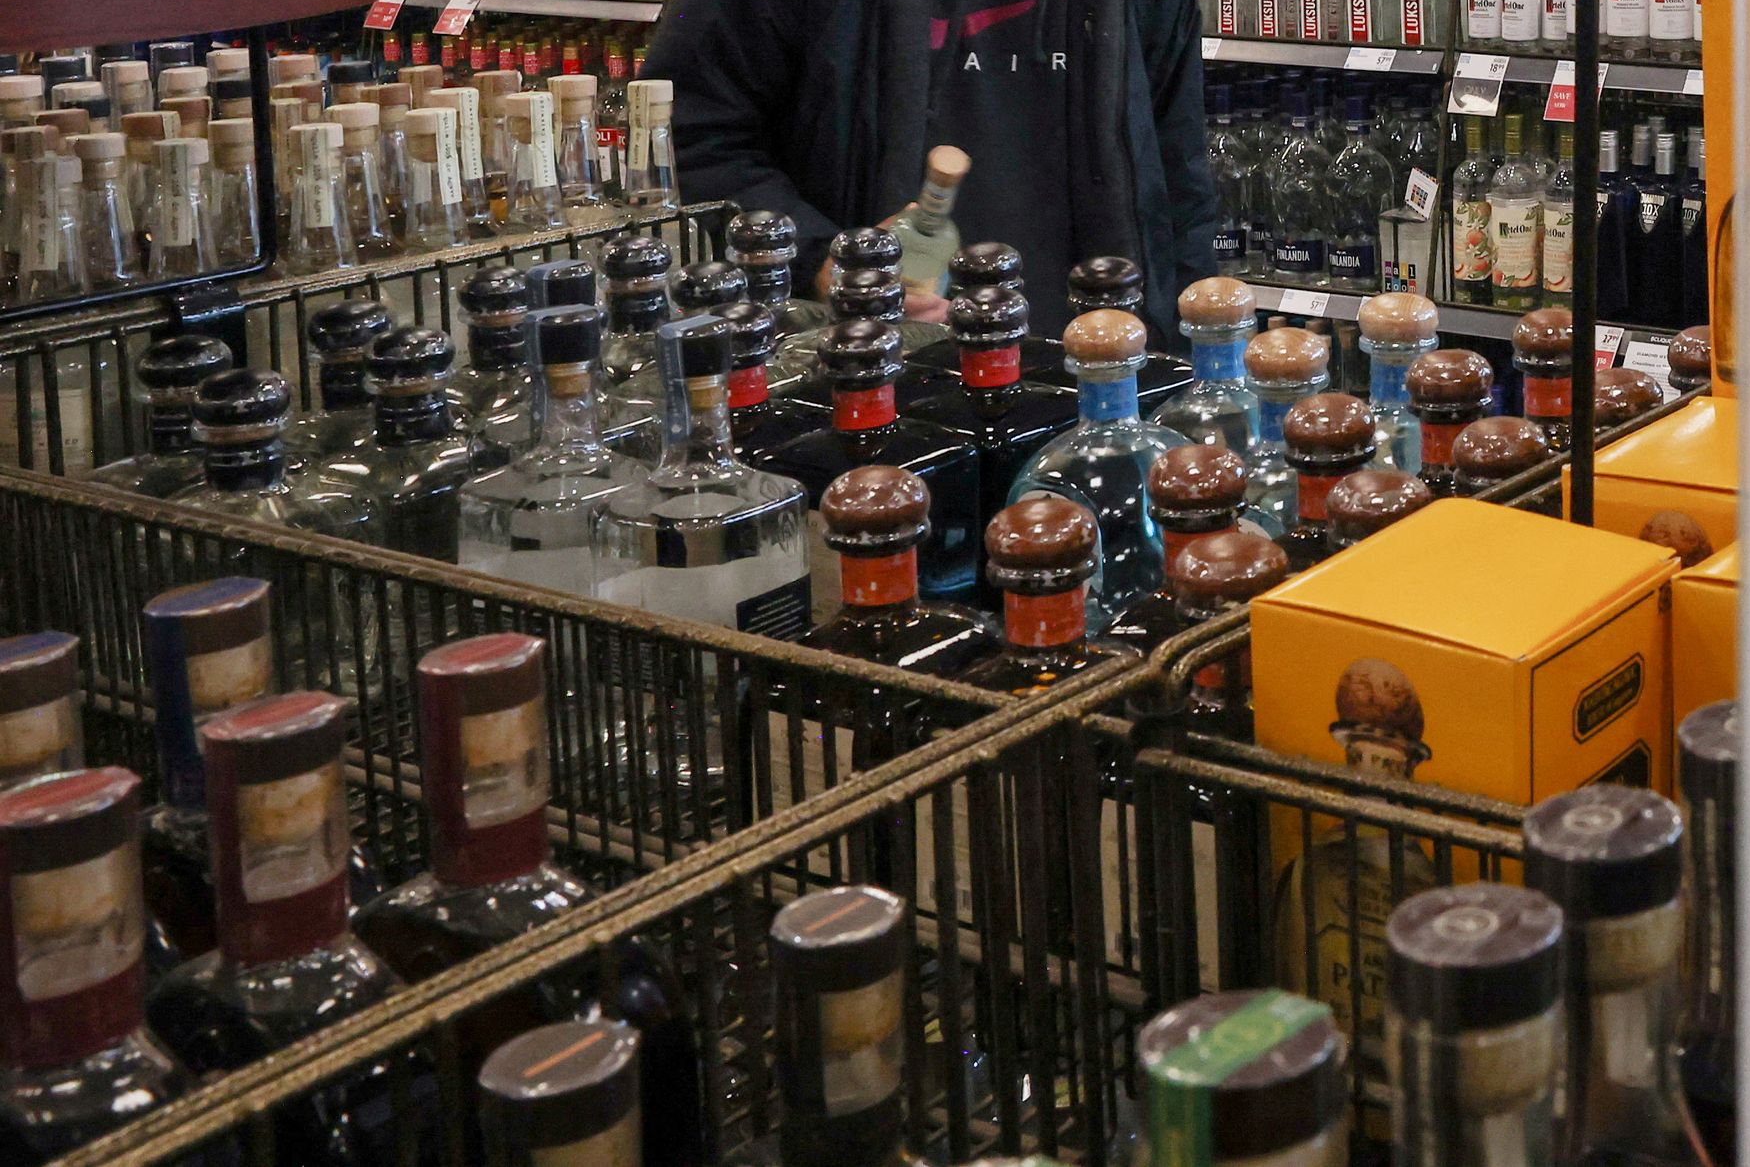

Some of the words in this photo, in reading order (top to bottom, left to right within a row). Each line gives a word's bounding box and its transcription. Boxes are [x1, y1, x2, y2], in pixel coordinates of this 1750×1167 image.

[963, 51, 1067, 72] AIR
[1553, 92, 1571, 100] SAVE
[1642, 203, 1660, 216] 10X
[1684, 209, 1697, 222] 10X
[1276, 248, 1310, 262] FINLANDIA
